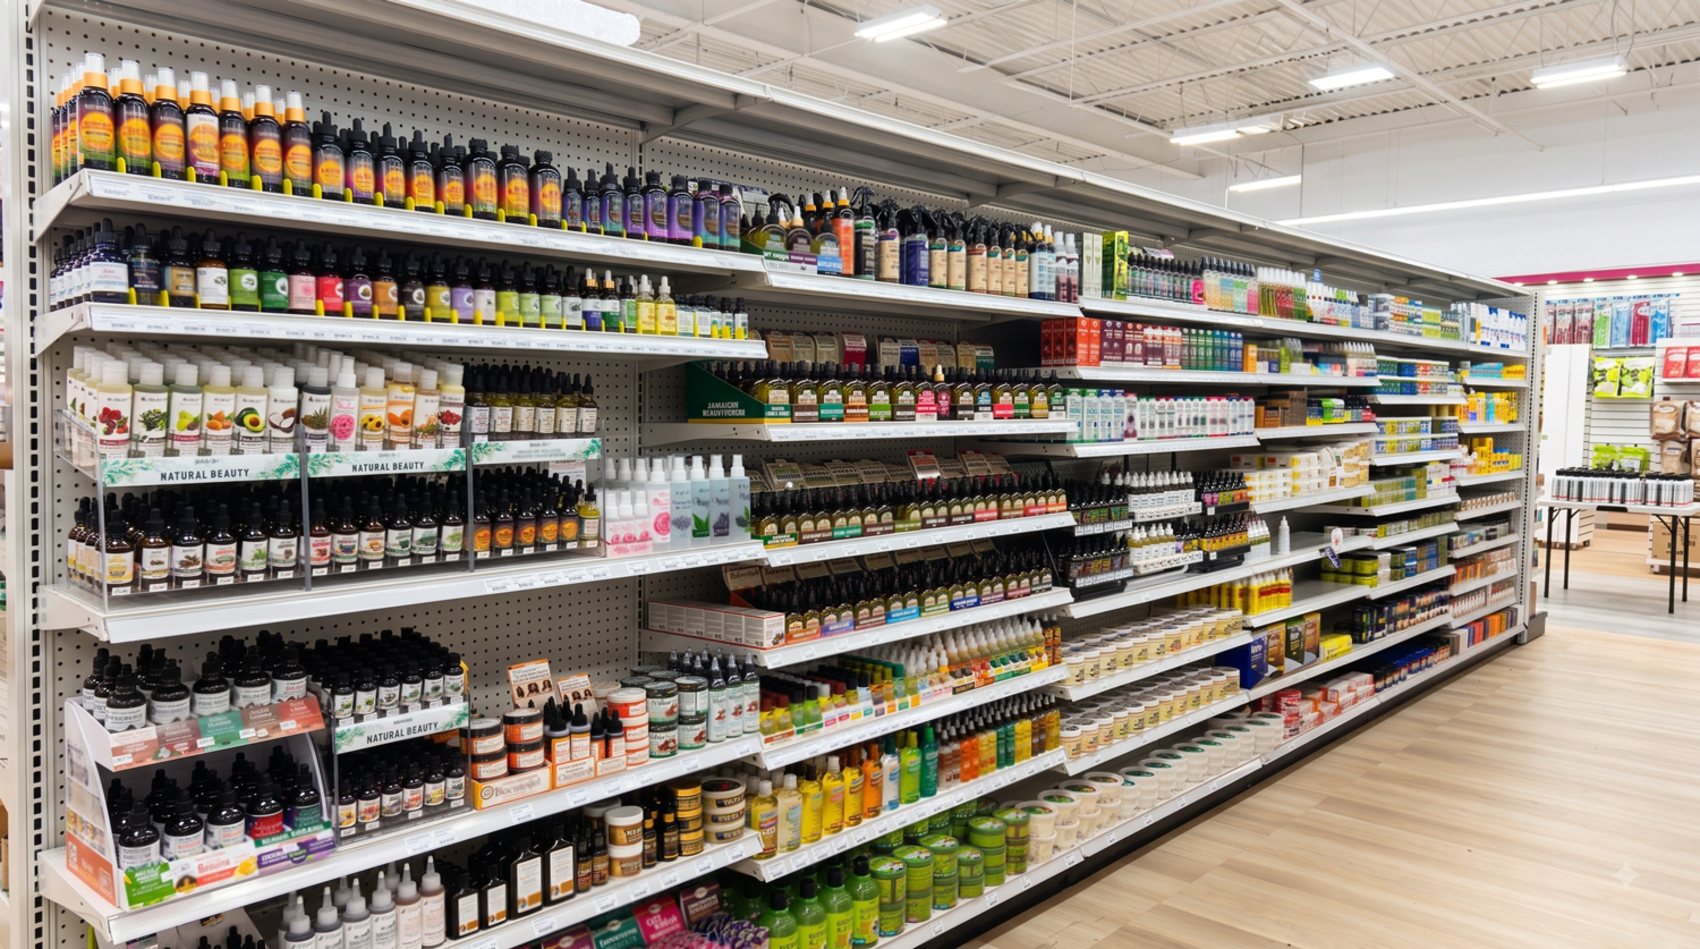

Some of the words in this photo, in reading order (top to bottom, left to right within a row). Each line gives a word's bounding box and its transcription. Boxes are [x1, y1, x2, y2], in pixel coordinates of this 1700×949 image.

[352, 463, 390, 473] NATURAL
[393, 461, 424, 471] BEAUTY
[160, 470, 207, 481] NATURAL
[210, 468, 249, 479] BEAUTY
[366, 730, 405, 744] NATURAL
[406, 721, 438, 736] BEAUTY
